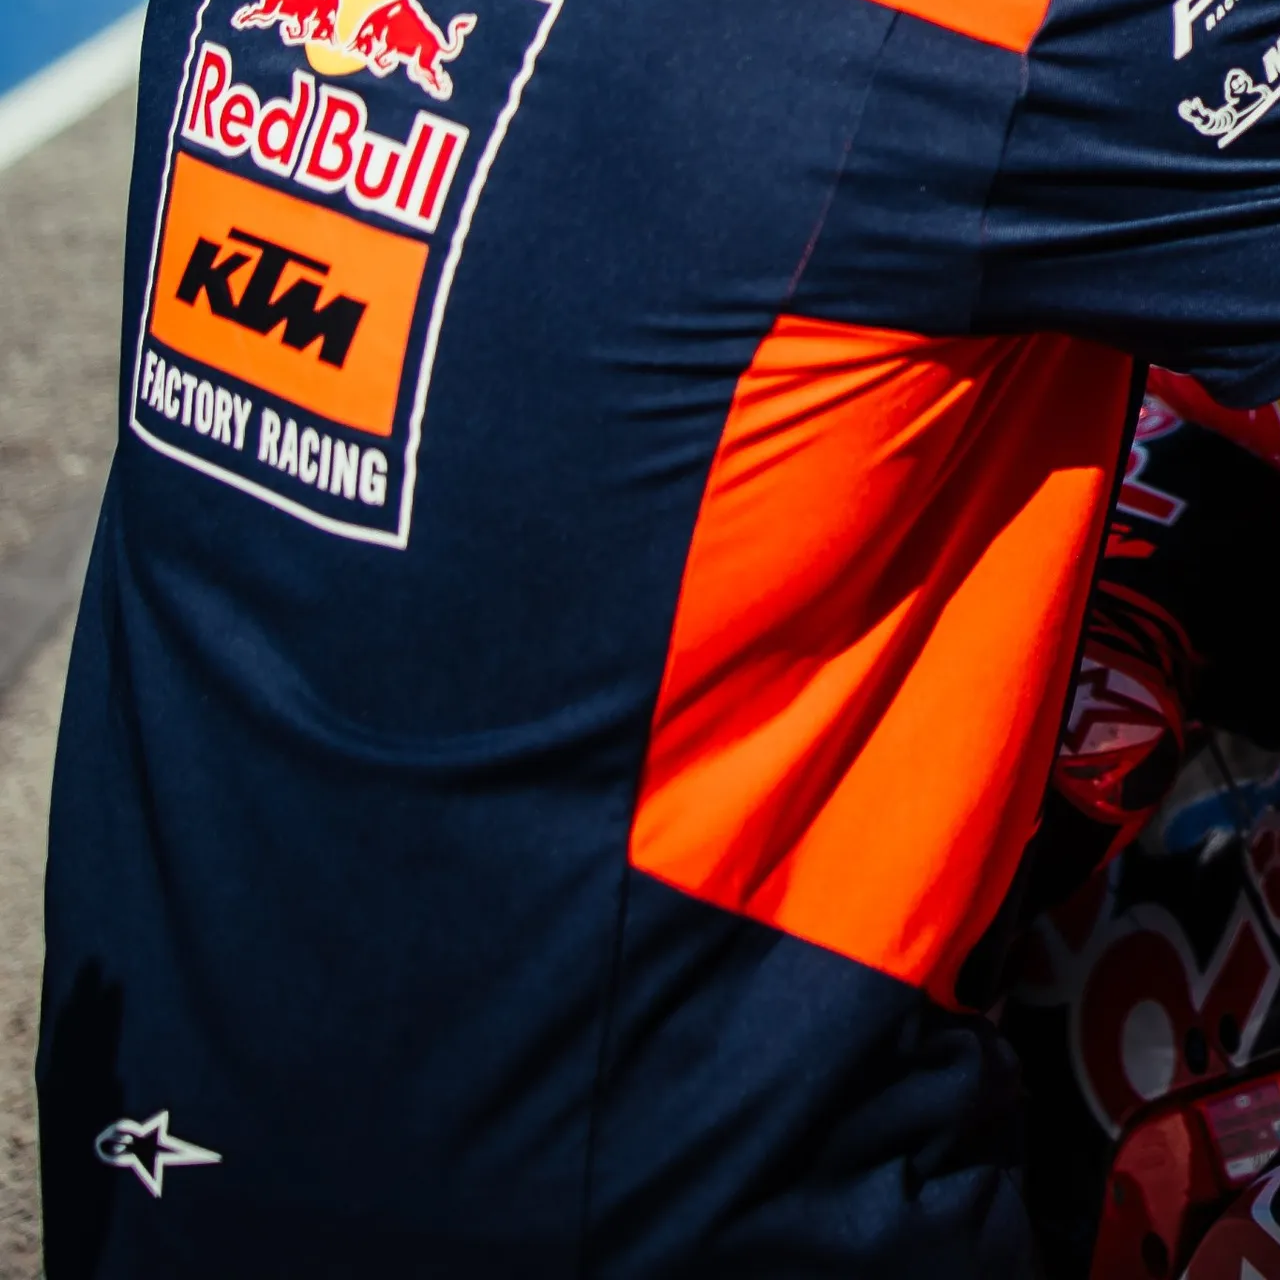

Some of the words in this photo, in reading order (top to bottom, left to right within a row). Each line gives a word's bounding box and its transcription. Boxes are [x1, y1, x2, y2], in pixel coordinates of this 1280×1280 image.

[183, 42, 312, 178] Red
[304, 83, 469, 233] Bull
[175, 226, 367, 370] KTM
[141, 349, 252, 450] FACTORY
[258, 407, 389, 506] RACING
